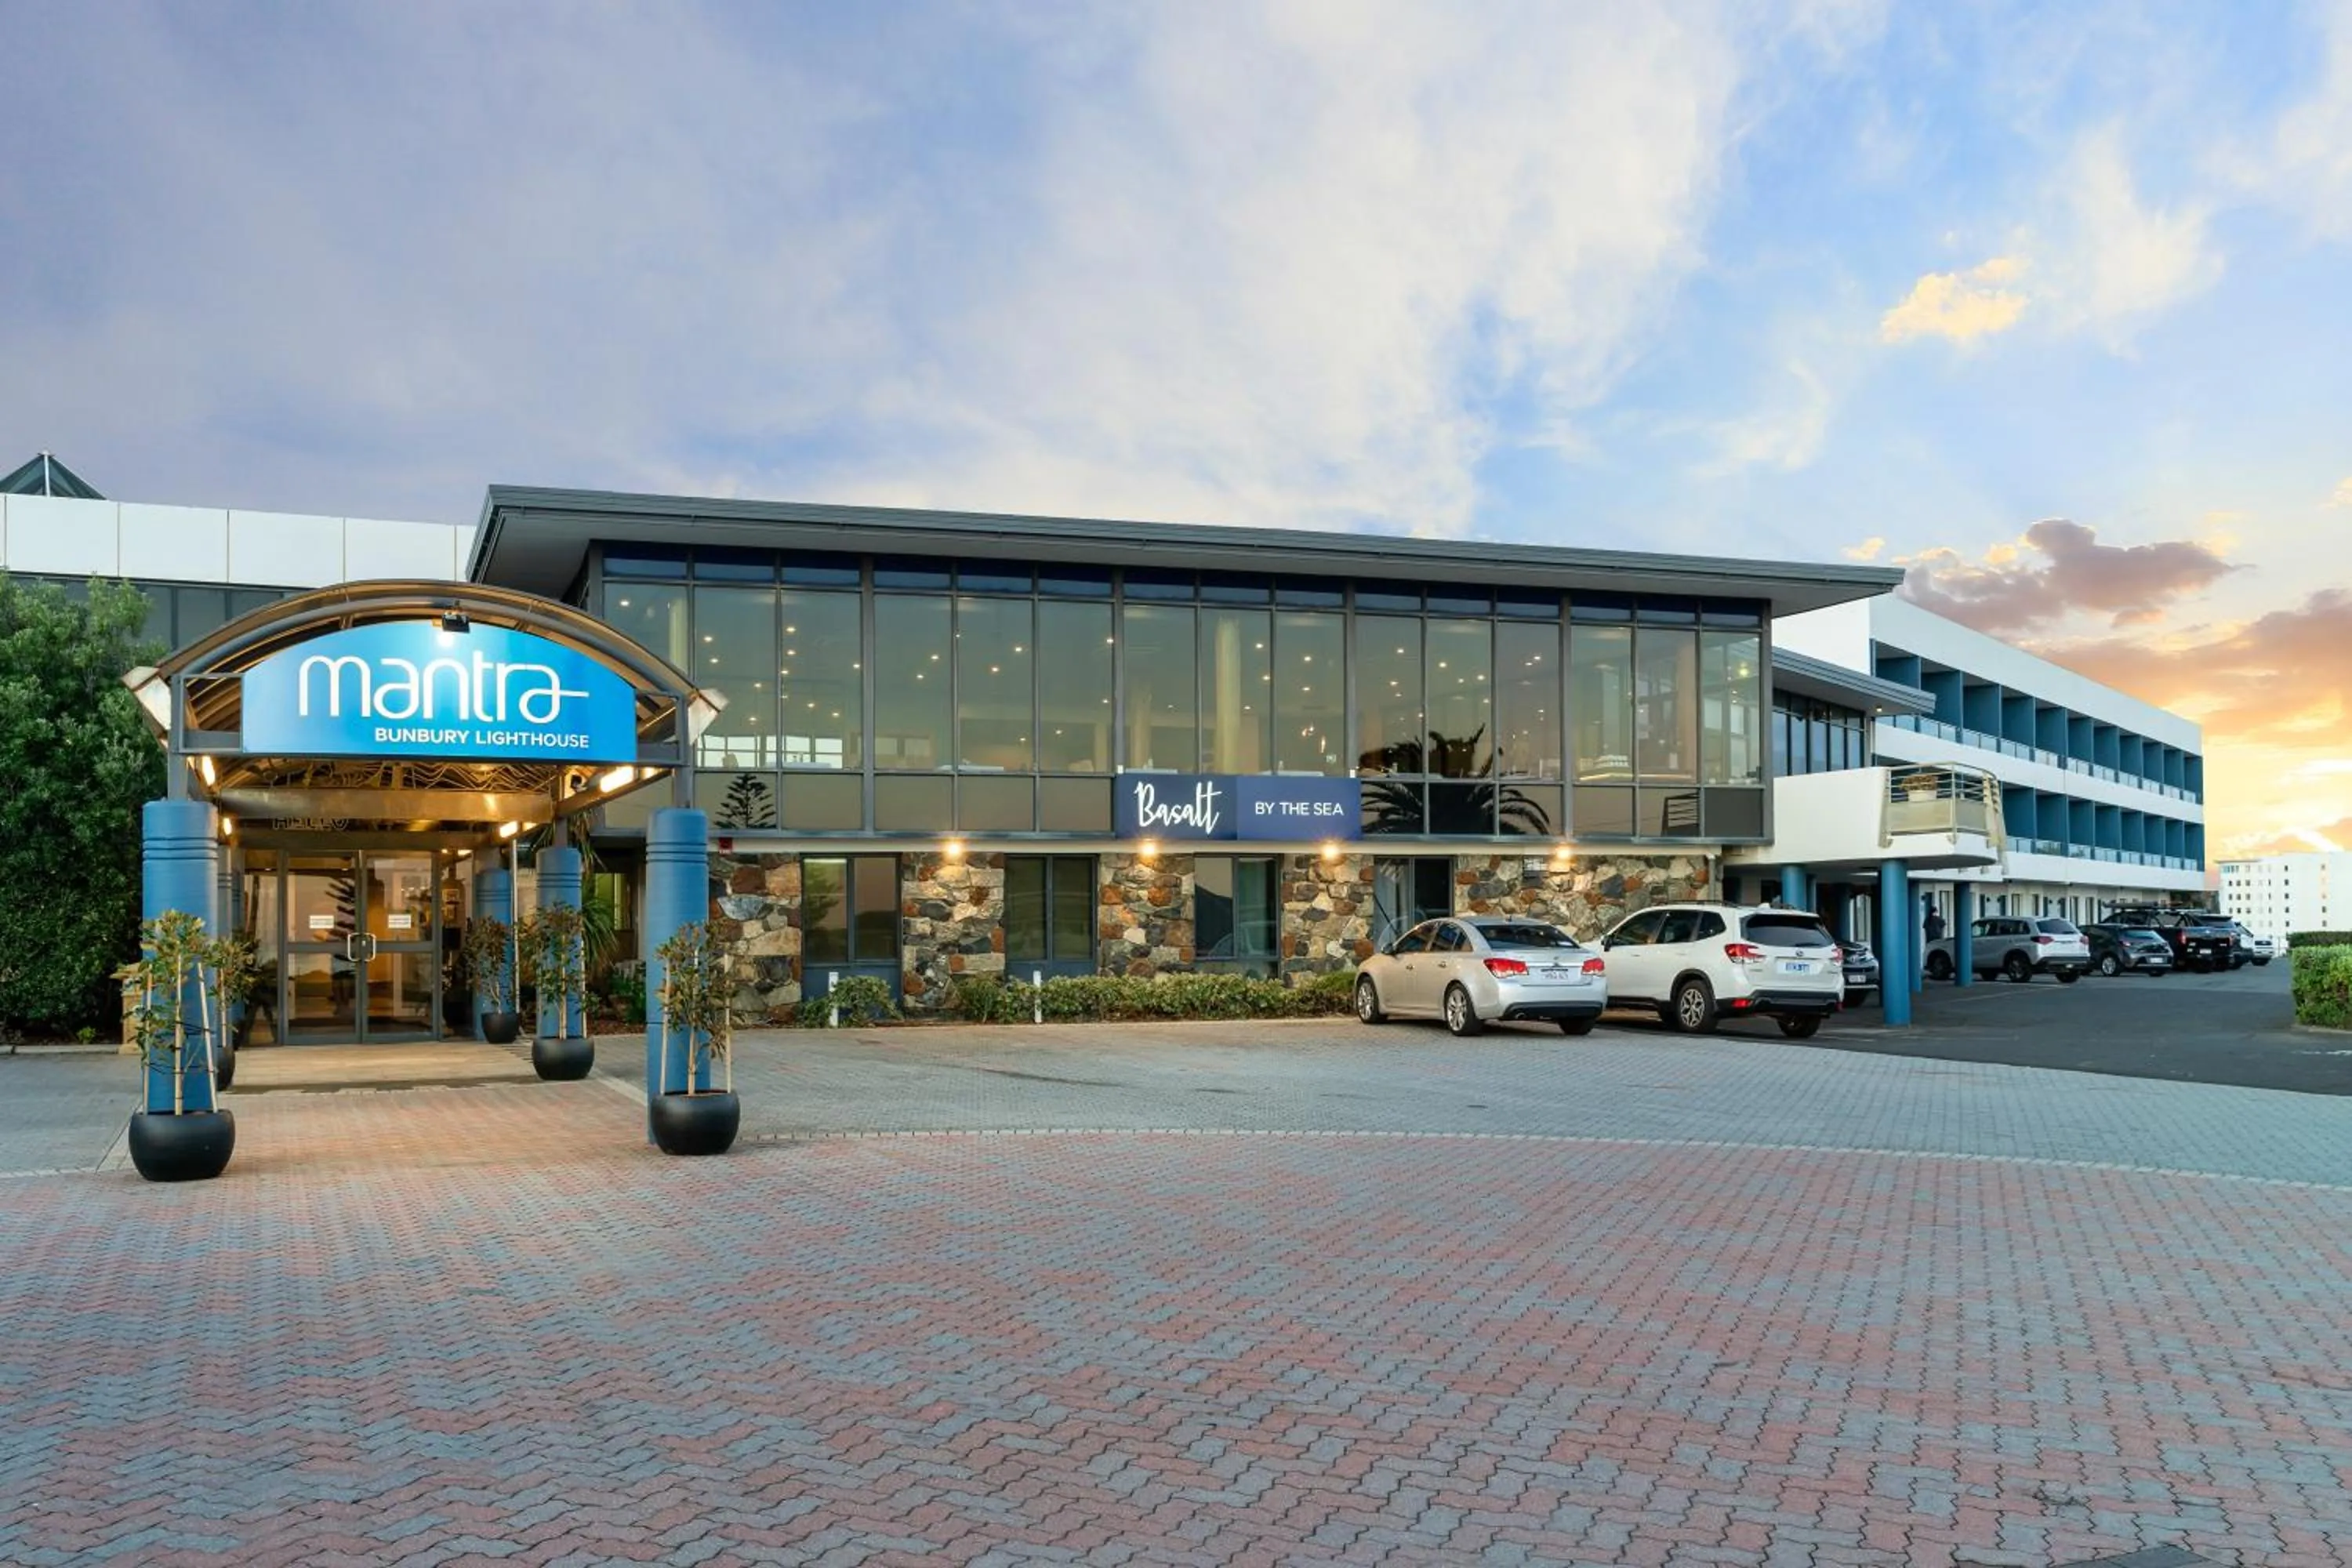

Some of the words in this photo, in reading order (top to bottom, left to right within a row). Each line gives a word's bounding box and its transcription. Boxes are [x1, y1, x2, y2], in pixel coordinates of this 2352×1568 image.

[298, 650, 590, 724] mantra
[375, 727, 469, 744] BUNBURY
[476, 730, 589, 748] LIGHTHOUSE
[1133, 781, 1222, 835] Basalt
[1254, 801, 1276, 815] BY
[1279, 801, 1309, 815] THE
[1313, 802, 1344, 816] SEA
